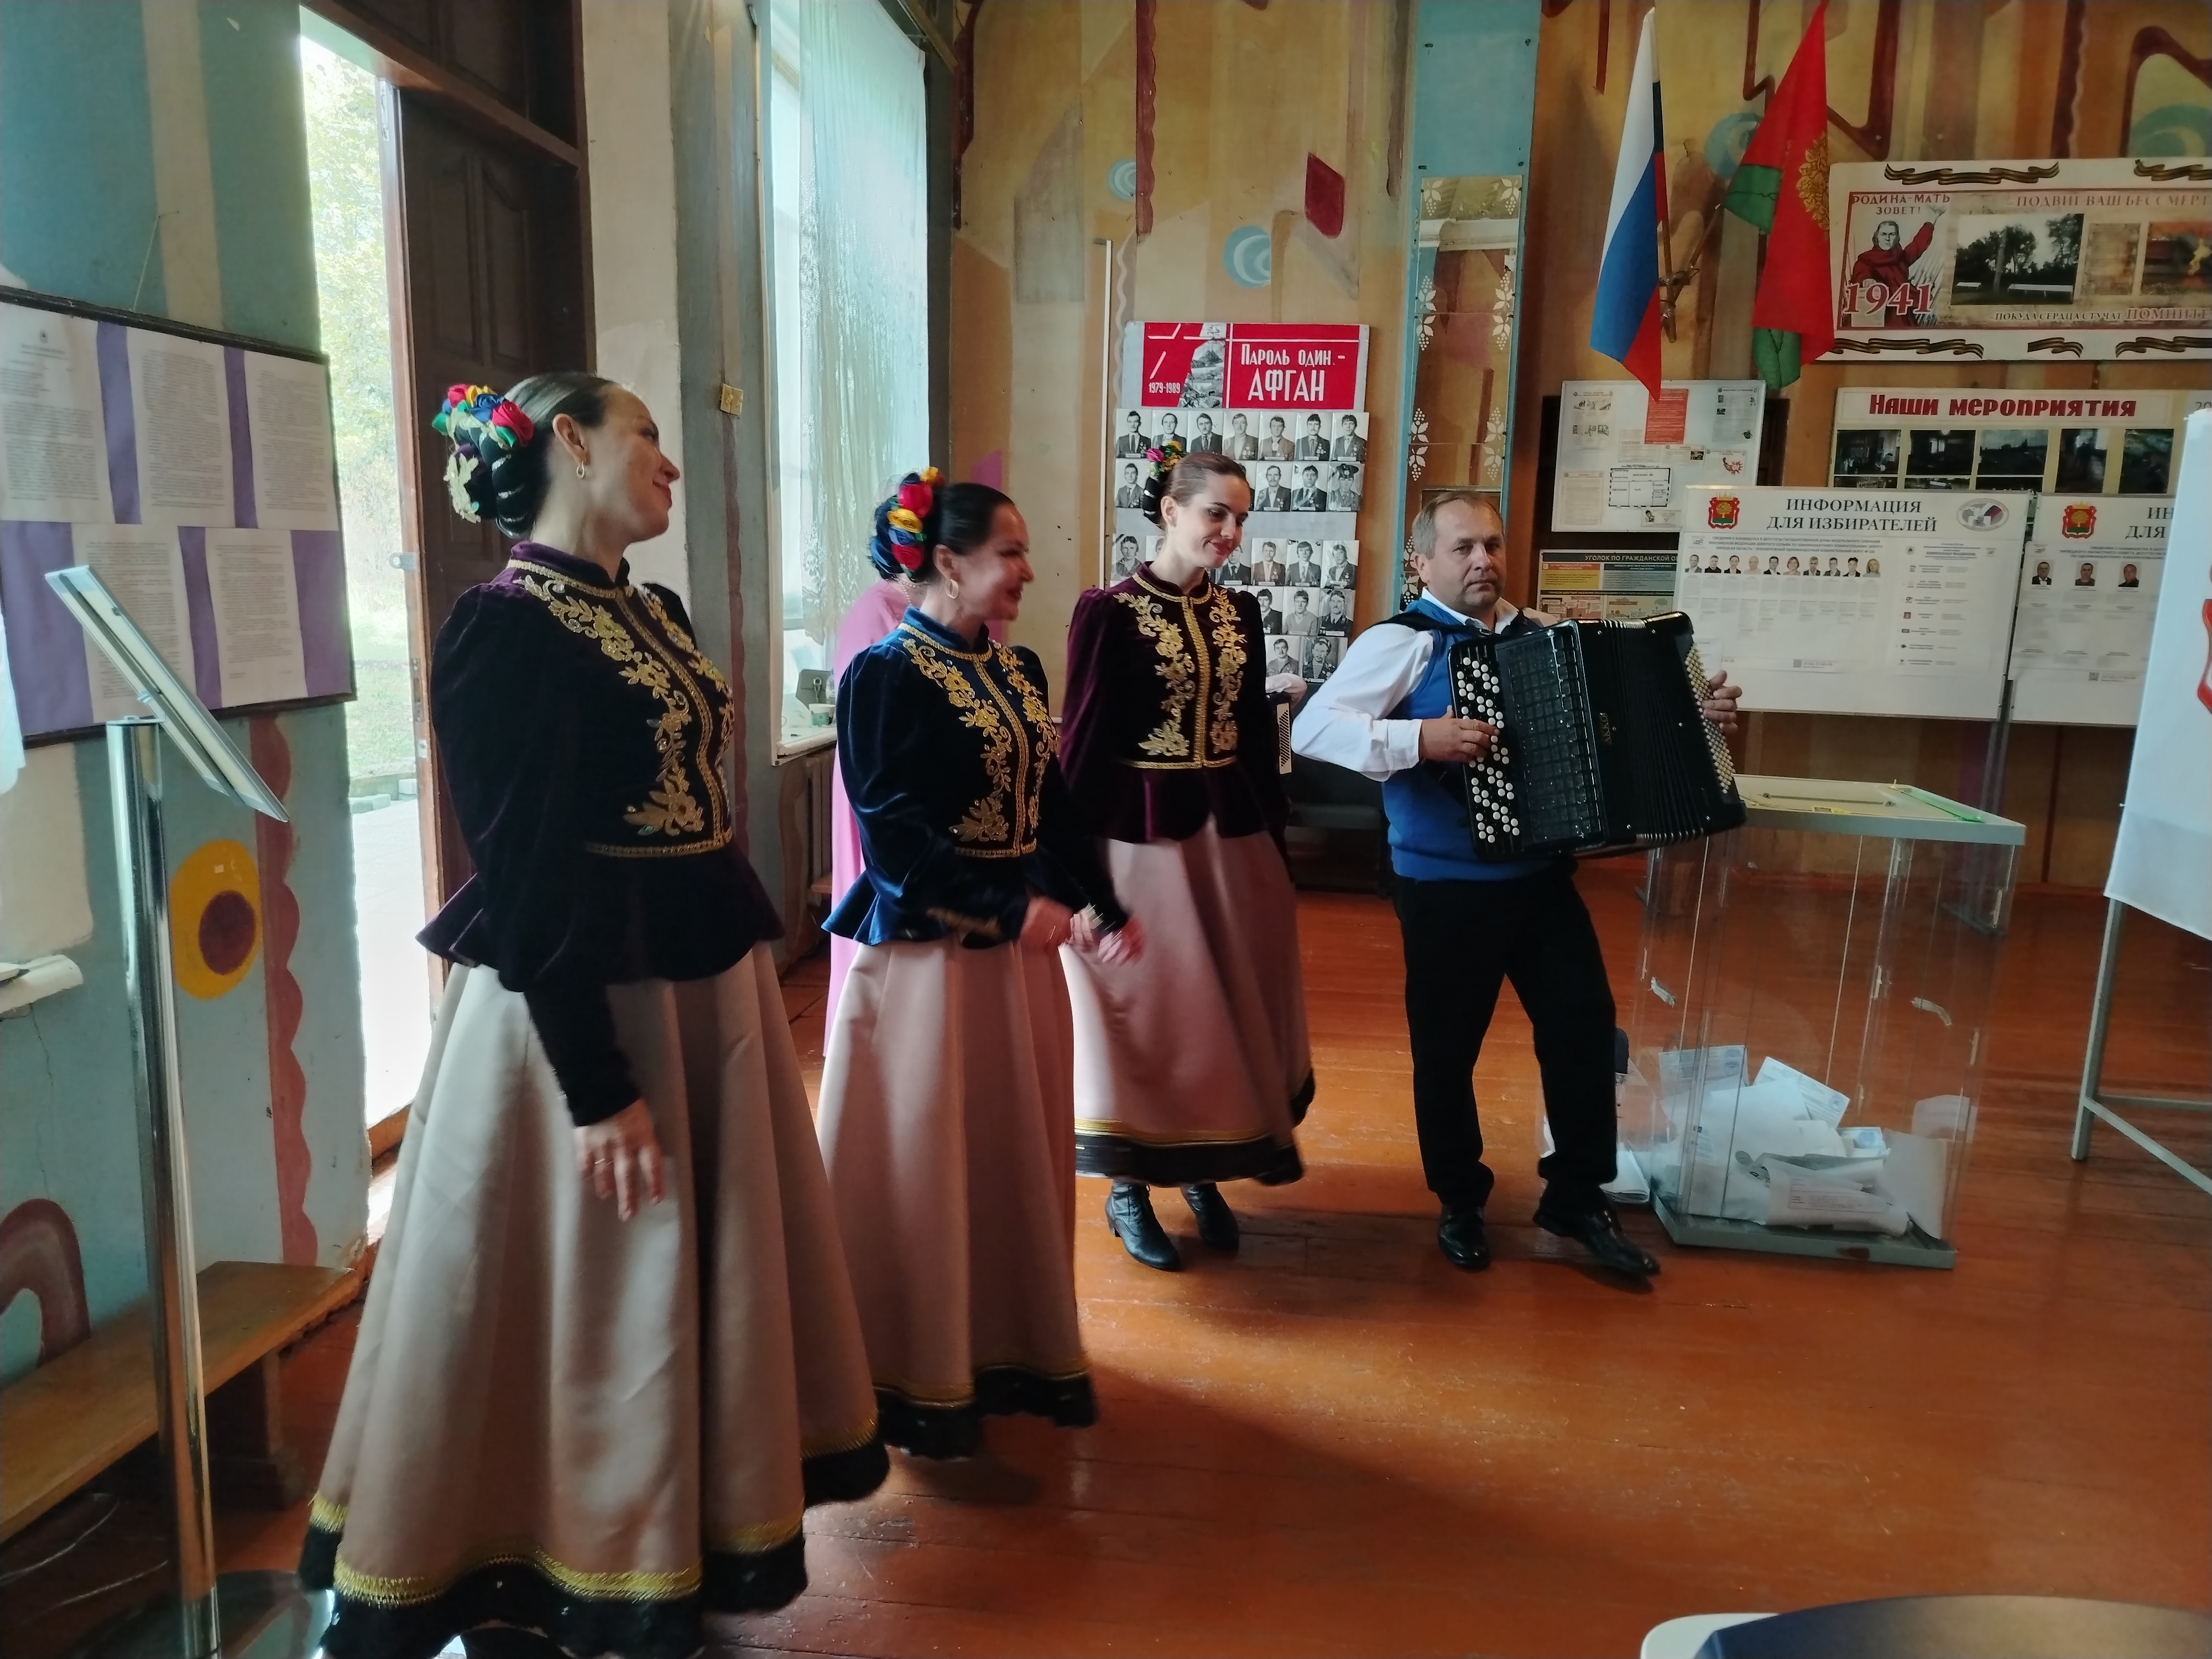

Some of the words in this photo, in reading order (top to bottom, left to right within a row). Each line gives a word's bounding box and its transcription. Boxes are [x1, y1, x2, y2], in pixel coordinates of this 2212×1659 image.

[1852, 194, 1950, 205] РОДИНА-МАТЬ
[2016, 196, 2080, 207] ПОДВИГ
[2086, 196, 2121, 206] ВАШ
[1876, 207, 1921, 215] ЗОВЕТ!
[1843, 283, 1932, 315] 1941
[1995, 312, 2037, 321] ПОКУДА
[1149, 382, 1180, 393] 1979-1989
[1248, 368, 1325, 401] АФГАН
[1786, 499, 1922, 514] ИНФОРМАЦИЯ
[1767, 517, 1804, 530] ДЛЯ
[1808, 517, 1937, 531] ИЗБИРАТЕЛЕЙ
[2125, 525, 2166, 539] ДЛЯ
